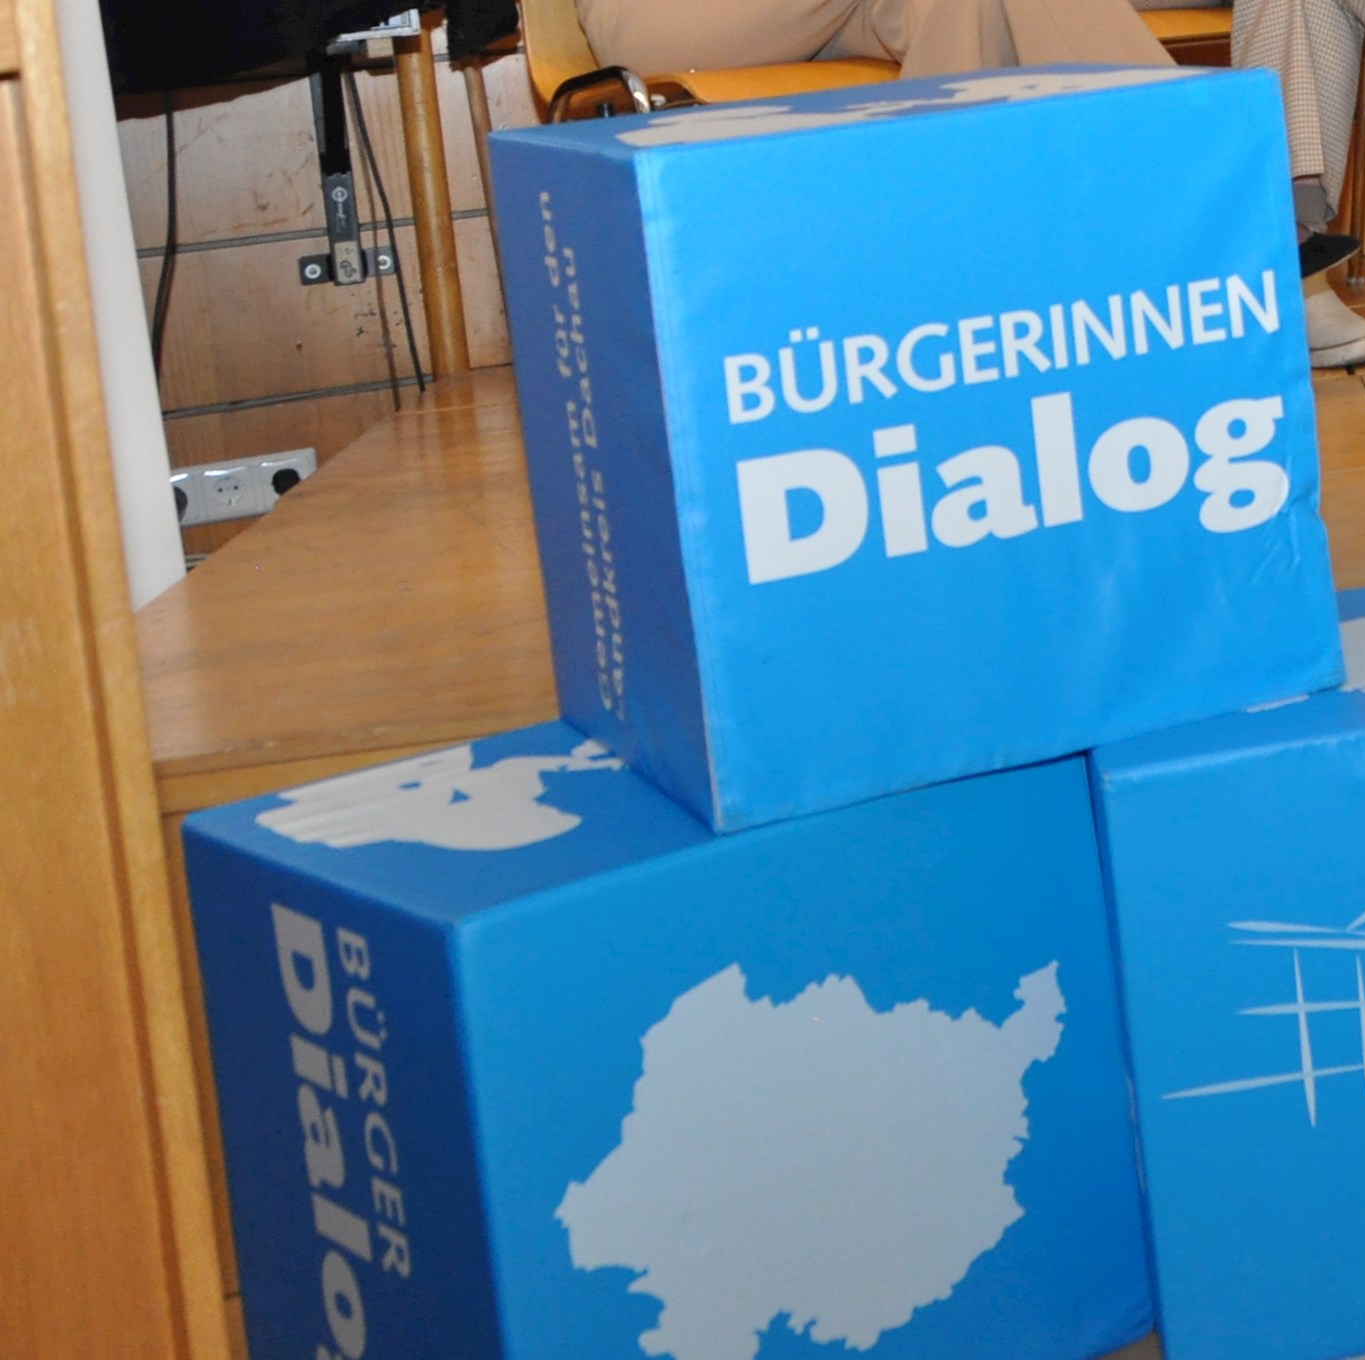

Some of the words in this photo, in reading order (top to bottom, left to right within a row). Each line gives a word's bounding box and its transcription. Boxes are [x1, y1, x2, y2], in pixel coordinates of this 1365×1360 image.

[538, 190, 561, 288] den
[554, 305, 573, 378] für
[562, 246, 598, 449] Dachau
[724, 270, 1280, 424] BÜRGERINNEN
[564, 400, 613, 711] Gemeinsam
[736, 392, 1290, 584] Dialog
[271, 904, 372, 1360] Dialo
[336, 928, 411, 1277] BÜRGER
